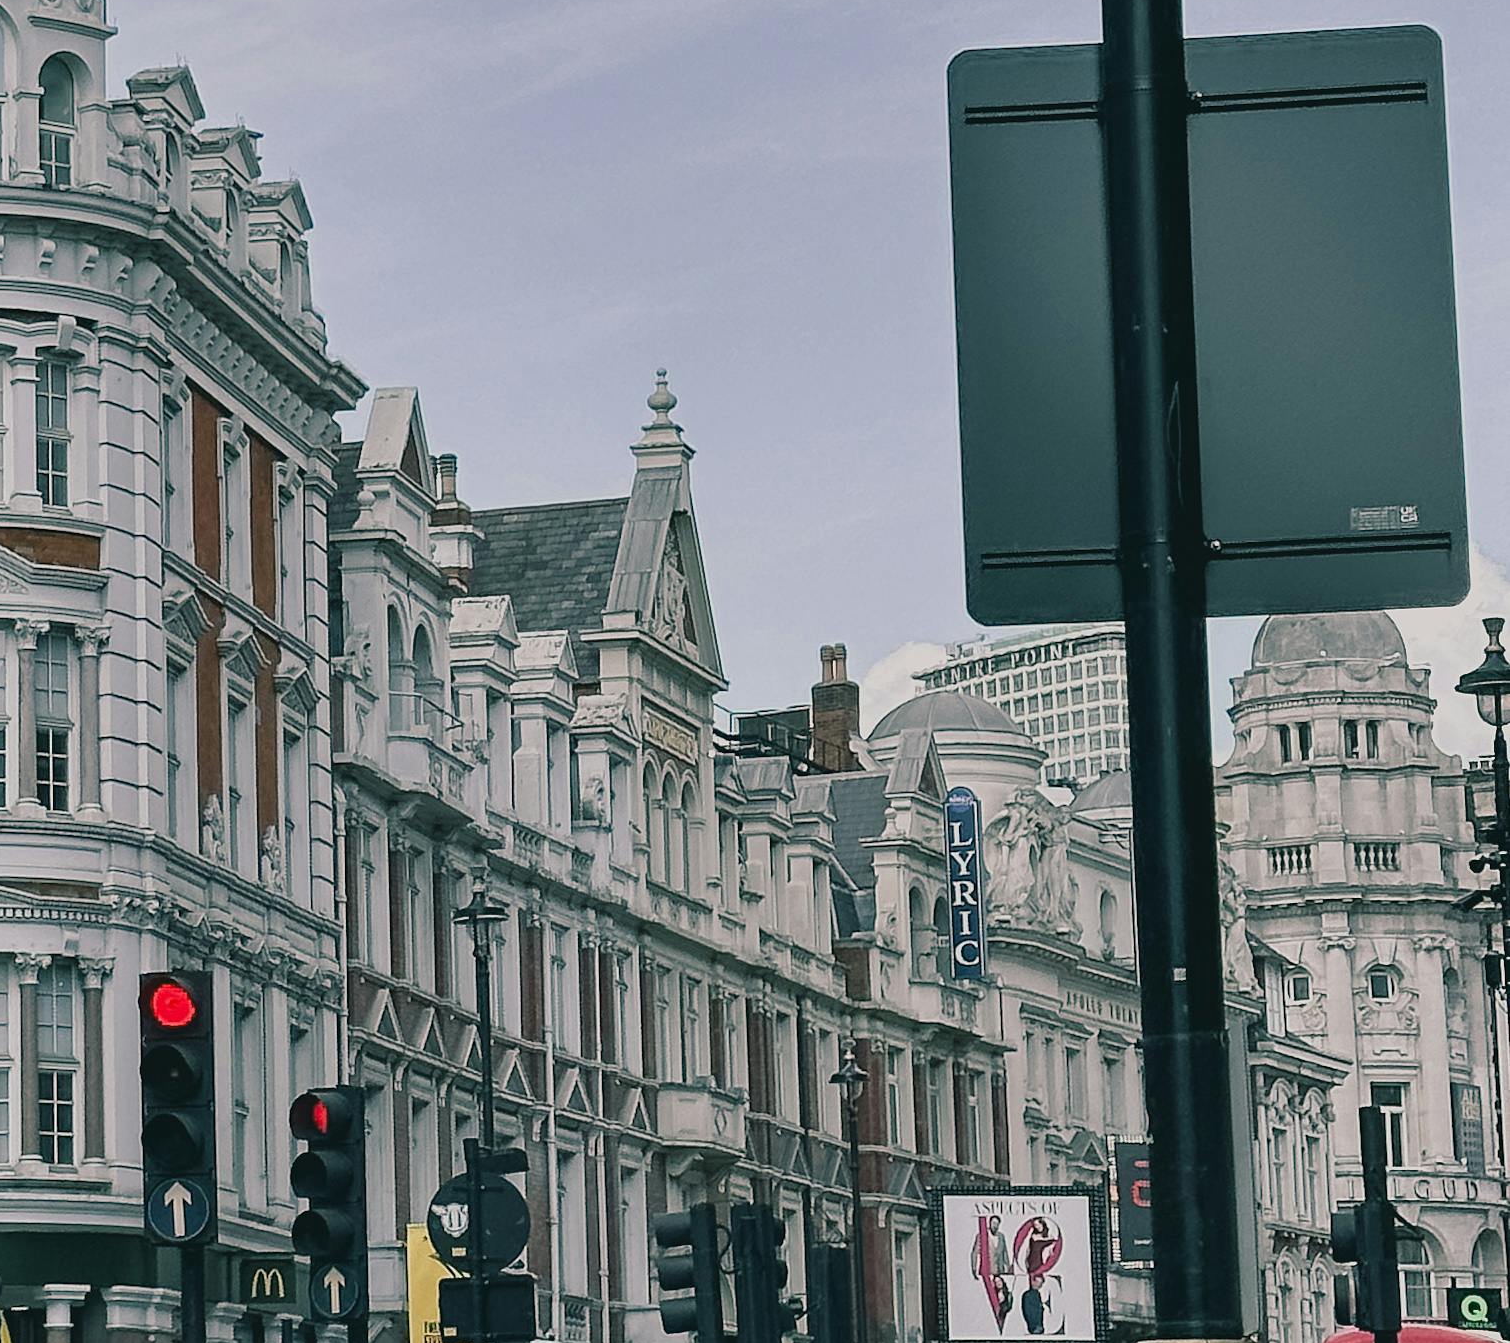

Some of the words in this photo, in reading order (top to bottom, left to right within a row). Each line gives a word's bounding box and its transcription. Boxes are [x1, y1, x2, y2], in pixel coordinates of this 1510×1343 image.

[1011, 642, 1075, 669] POINT
[949, 821, 980, 966] LYRIC
[1109, 1003, 1139, 1025] THEAT
[1347, 1178, 1479, 1201] ILGUD
[974, 1201, 1038, 1216] ASPECTS
[1041, 1201, 1060, 1215] OF
[1460, 1294, 1489, 1323] Q
